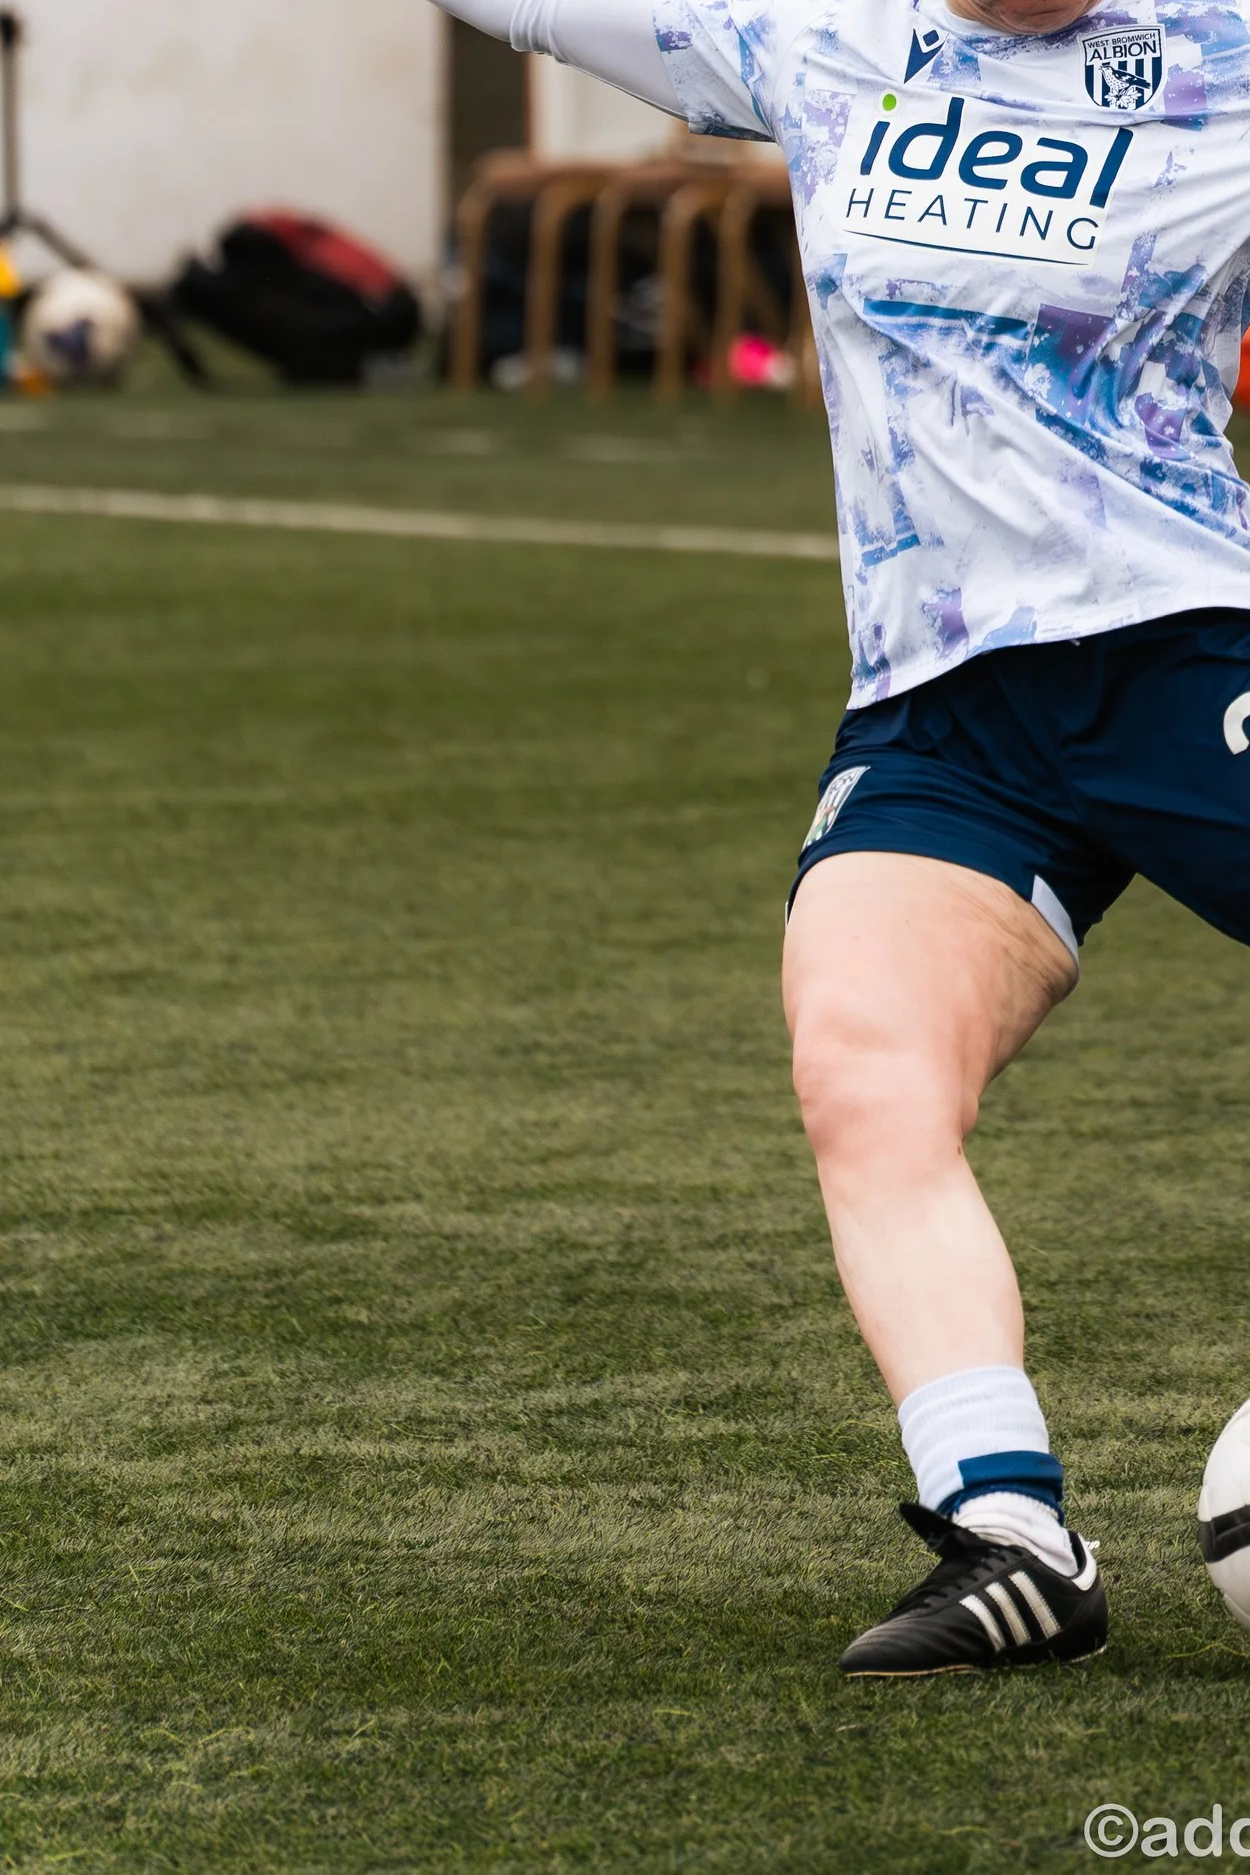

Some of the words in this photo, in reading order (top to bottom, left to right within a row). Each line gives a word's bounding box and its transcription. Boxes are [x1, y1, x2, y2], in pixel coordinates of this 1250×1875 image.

[1087, 39, 1110, 49] WEST
[1112, 32, 1156, 45] BROMWICH
[1089, 40, 1157, 63] ALBION
[860, 93, 1134, 208] ideal
[846, 188, 1100, 250] HEATING
